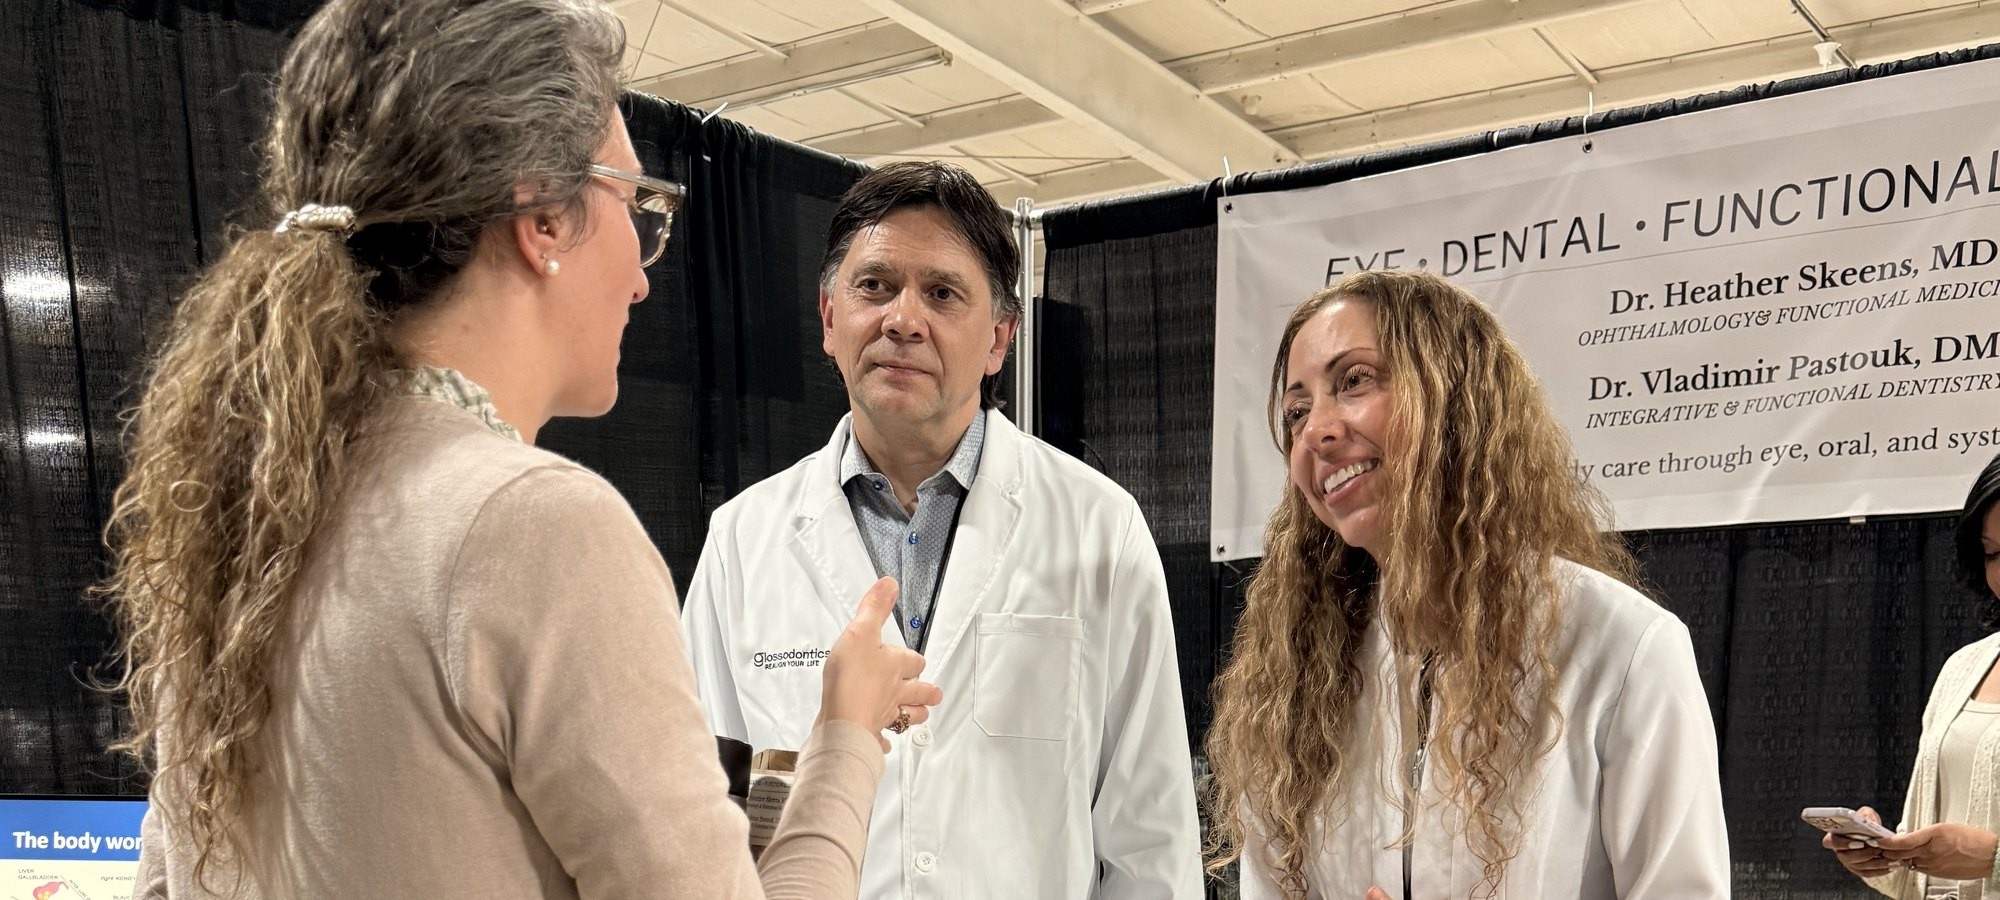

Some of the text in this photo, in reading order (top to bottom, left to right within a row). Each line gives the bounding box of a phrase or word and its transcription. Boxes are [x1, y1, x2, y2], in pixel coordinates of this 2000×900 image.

[1442, 213, 1620, 277] DENTAL
[1663, 150, 2000, 242] FUNCTIONAL
[1609, 239, 1998, 315] Dr. Heather Skeens, MD
[1776, 289, 1910, 324] FUNCTIONAL
[1915, 279, 2000, 304] MEDICI
[1588, 331, 2000, 400] Dr. Vladimir Pastouk, DM
[1585, 403, 1718, 429] INTEGRATIVE
[1723, 400, 1740, 416] &
[1742, 382, 1872, 416] FUNCTIONAL
[1602, 460, 1651, 478] care
[1659, 444, 1752, 473] through
[1760, 442, 1808, 466] eye,
[1818, 432, 1877, 458] oral,
[1887, 427, 1938, 453] and
[1947, 426, 2000, 454] syst
[753, 648, 830, 667] glossodontics
[12, 831, 48, 849] The
[53, 832, 102, 853] body
